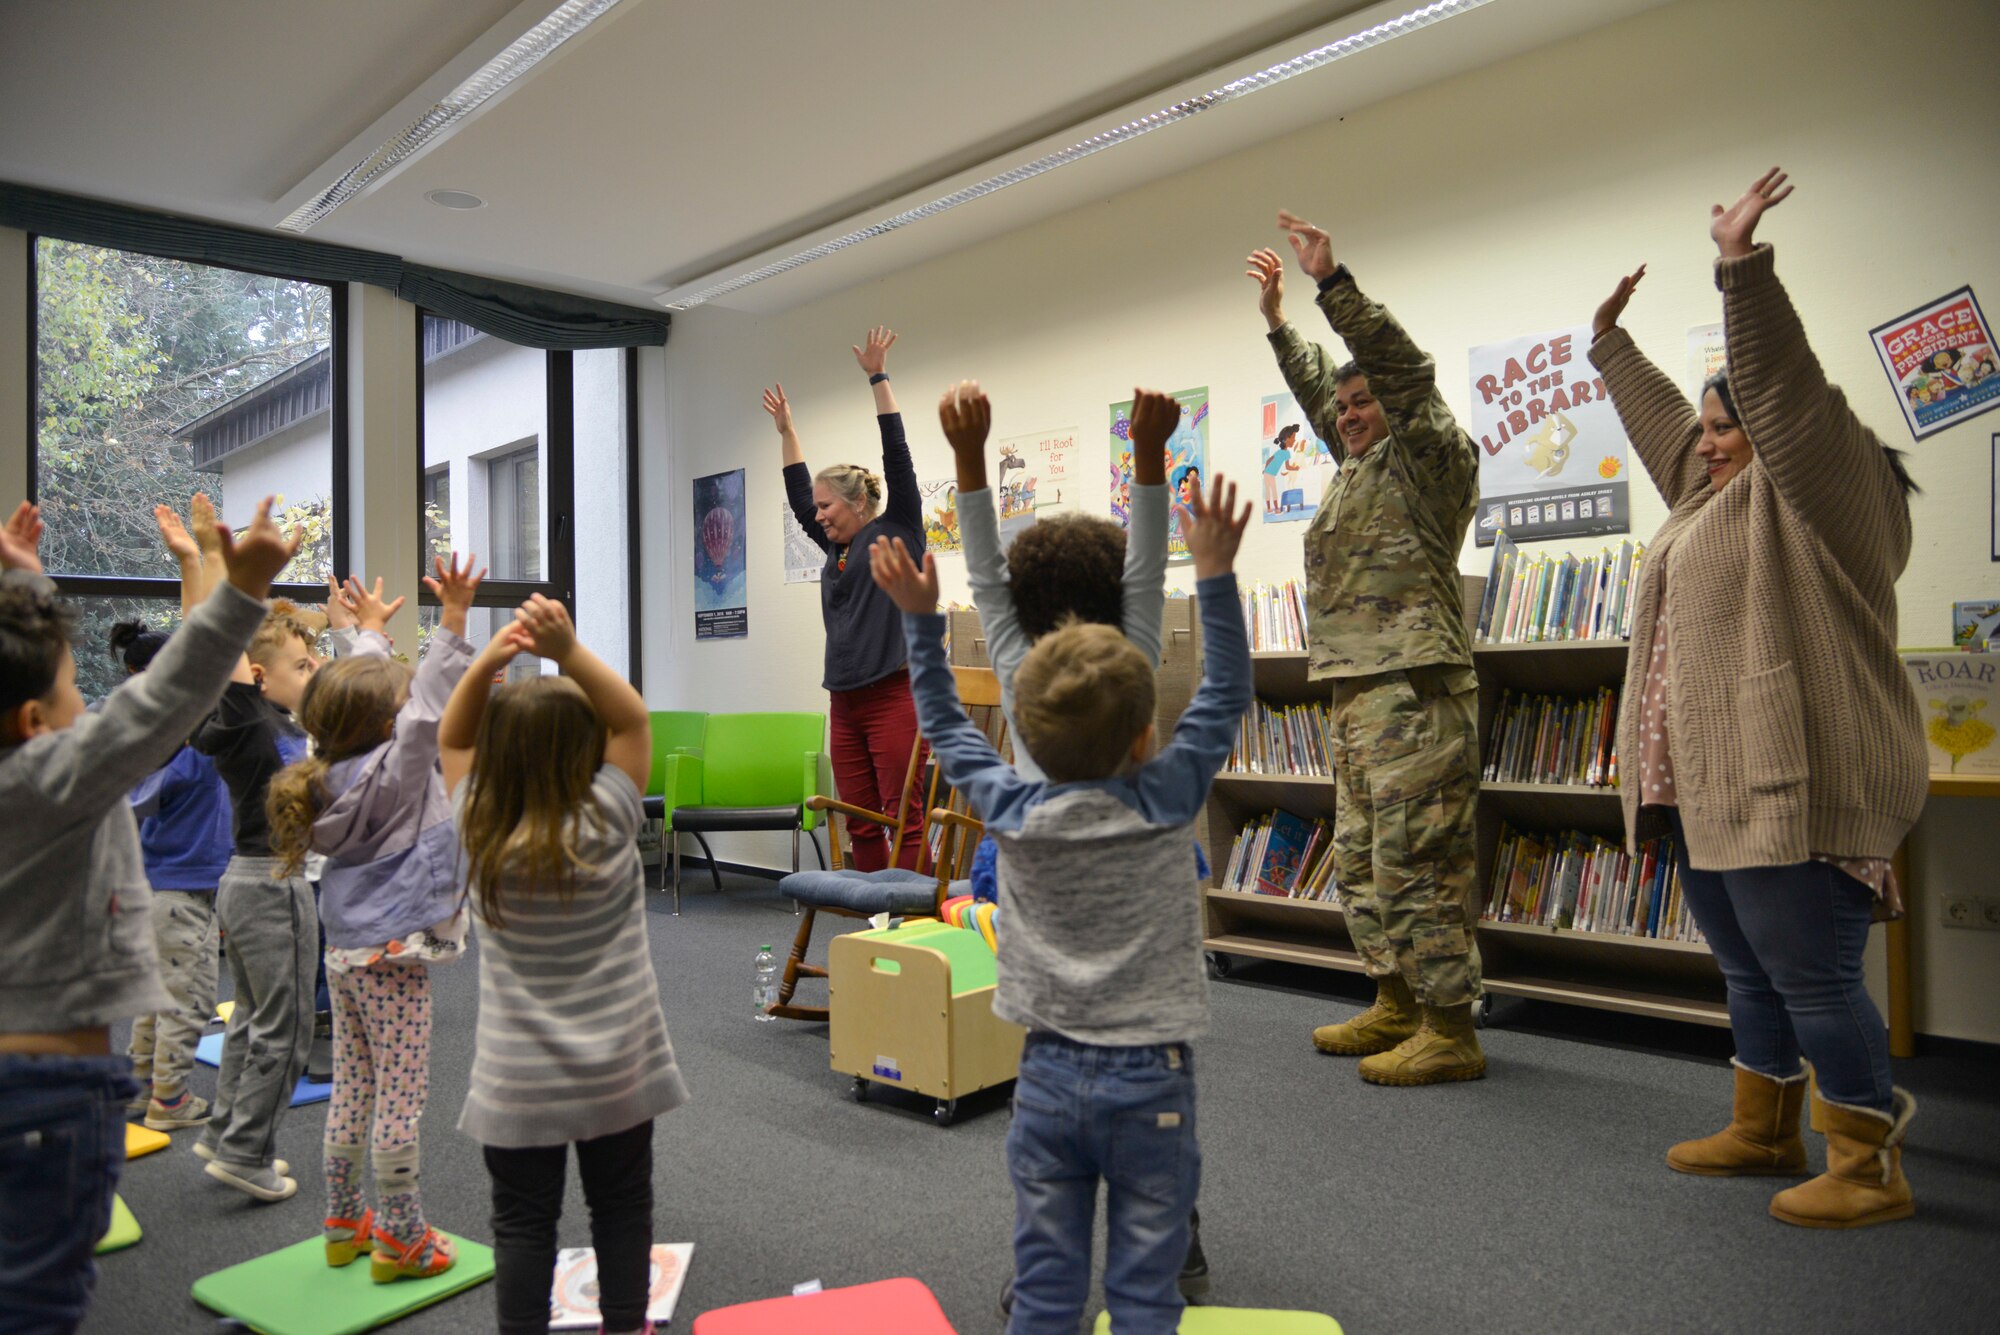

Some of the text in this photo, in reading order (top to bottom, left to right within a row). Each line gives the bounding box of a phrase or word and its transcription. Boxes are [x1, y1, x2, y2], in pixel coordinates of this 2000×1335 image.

[1888, 308, 1973, 355] GRACE
[1919, 332, 1945, 347] FOR
[1896, 329, 1979, 373] PRESIDENT
[1476, 334, 1572, 405] RACE
[1499, 370, 1564, 413] TO THE
[1481, 377, 1607, 456] LIBRARY
[1050, 452, 1063, 462] for
[1054, 435, 1073, 449] Root
[1049, 464, 1065, 474] You
[1917, 660, 1997, 684] ROAR
